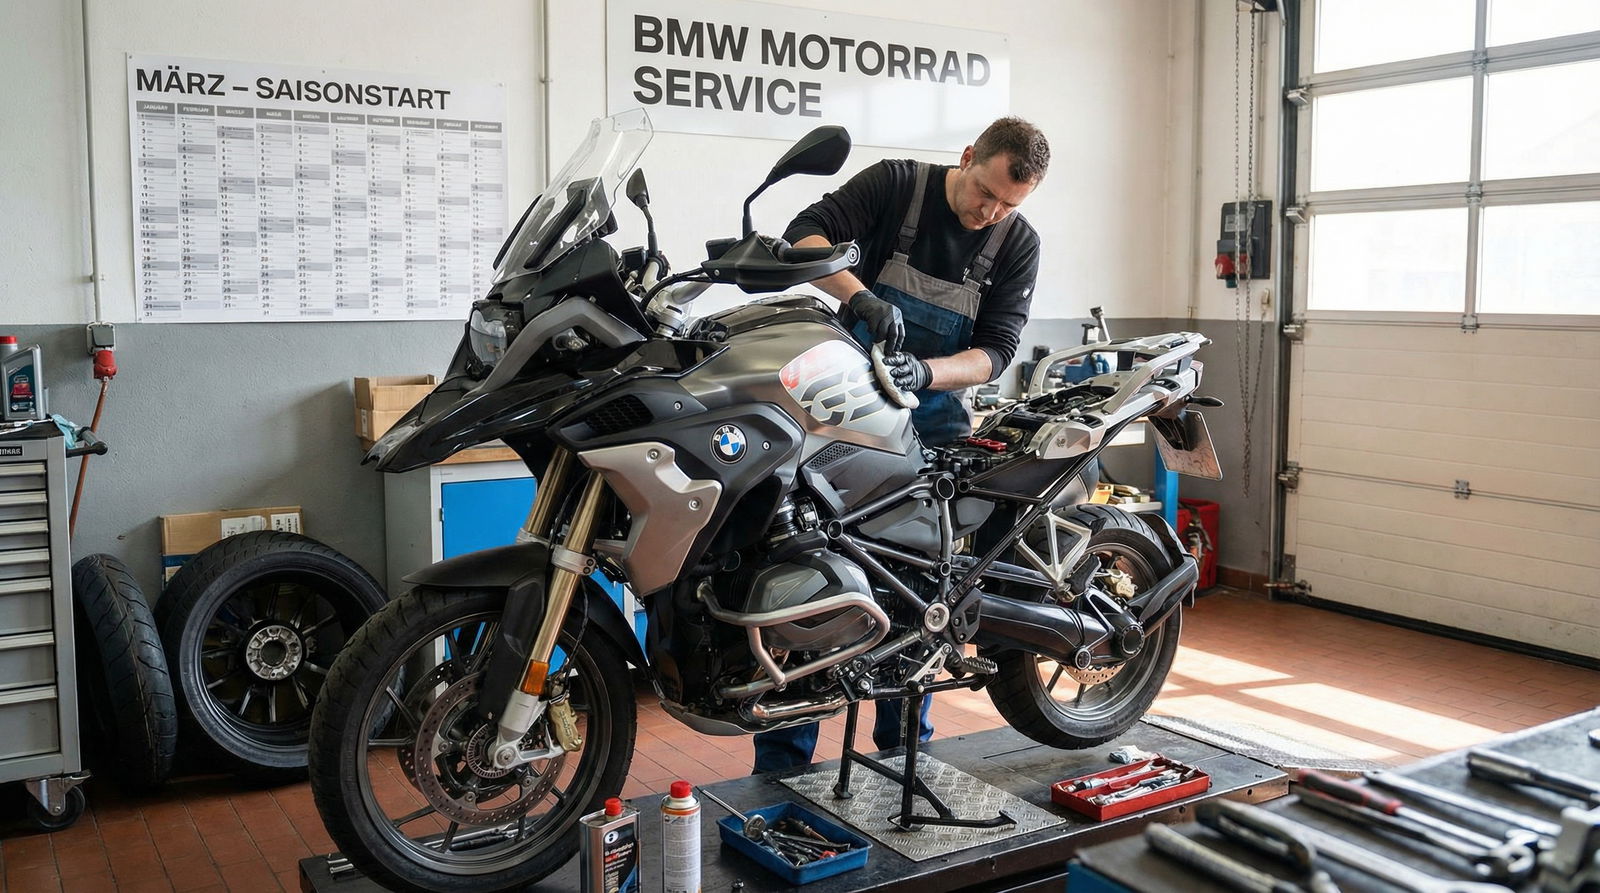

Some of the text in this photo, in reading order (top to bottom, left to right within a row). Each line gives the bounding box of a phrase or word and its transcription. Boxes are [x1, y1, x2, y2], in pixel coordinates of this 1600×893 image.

[634, 14, 991, 87] BMW MOTORRAD
[137, 66, 225, 96] MÄRZ
[257, 78, 450, 110] SAISONSTART
[633, 66, 823, 118] SERVICE
